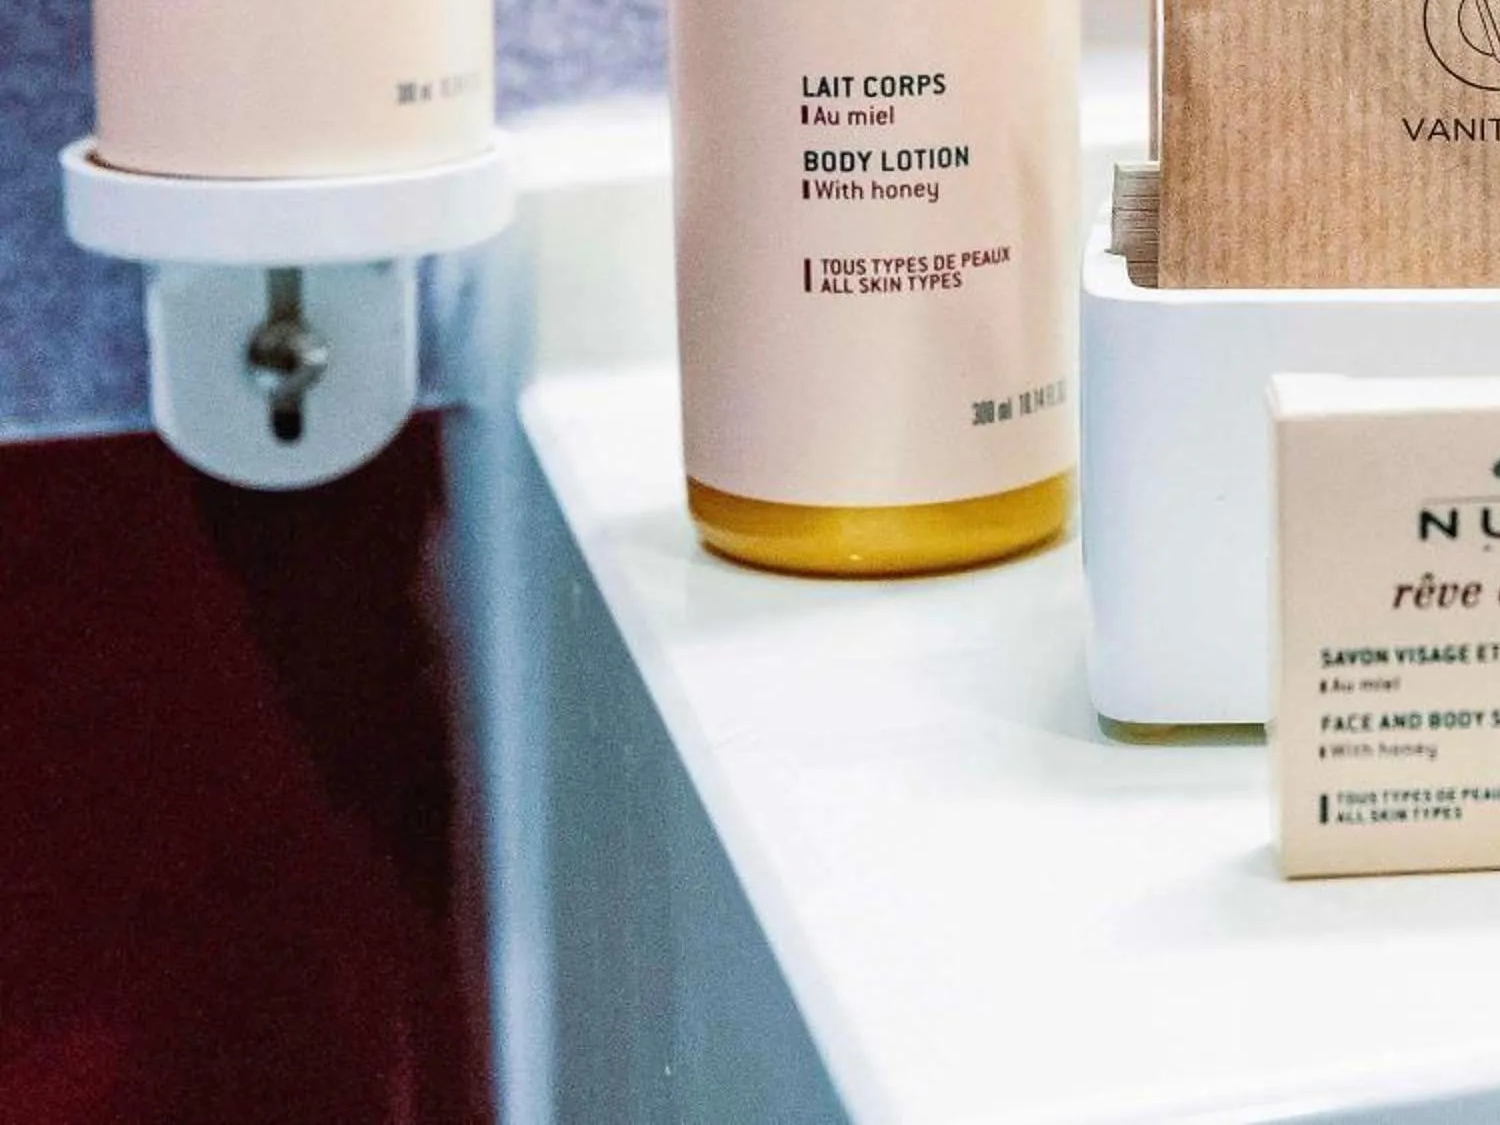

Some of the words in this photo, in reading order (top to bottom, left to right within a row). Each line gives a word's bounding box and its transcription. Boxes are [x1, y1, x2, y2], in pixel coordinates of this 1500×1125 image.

[802, 76, 854, 98] LAIT
[863, 73, 946, 98] CORPS
[813, 106, 840, 125] Au
[847, 105, 895, 125] miel
[803, 150, 872, 172] BODY
[881, 145, 970, 172] LOTION
[814, 179, 864, 200] With
[871, 180, 940, 203] honey
[820, 258, 867, 275] TOUS
[873, 256, 927, 274] TYPES
[933, 253, 955, 271] DE
[961, 246, 1011, 269] PEAUX
[820, 277, 854, 294] ALL
[859, 276, 901, 293] SKIN
[908, 271, 963, 291] TYPES
[1393, 572, 1482, 610] rêve
[1321, 647, 1389, 668] SAVON
[1394, 644, 1468, 666] VISAGE
[1476, 643, 1500, 663] ET
[1321, 713, 1372, 732] FACE
[1379, 712, 1422, 730] AND
[1428, 710, 1485, 730] BODY
